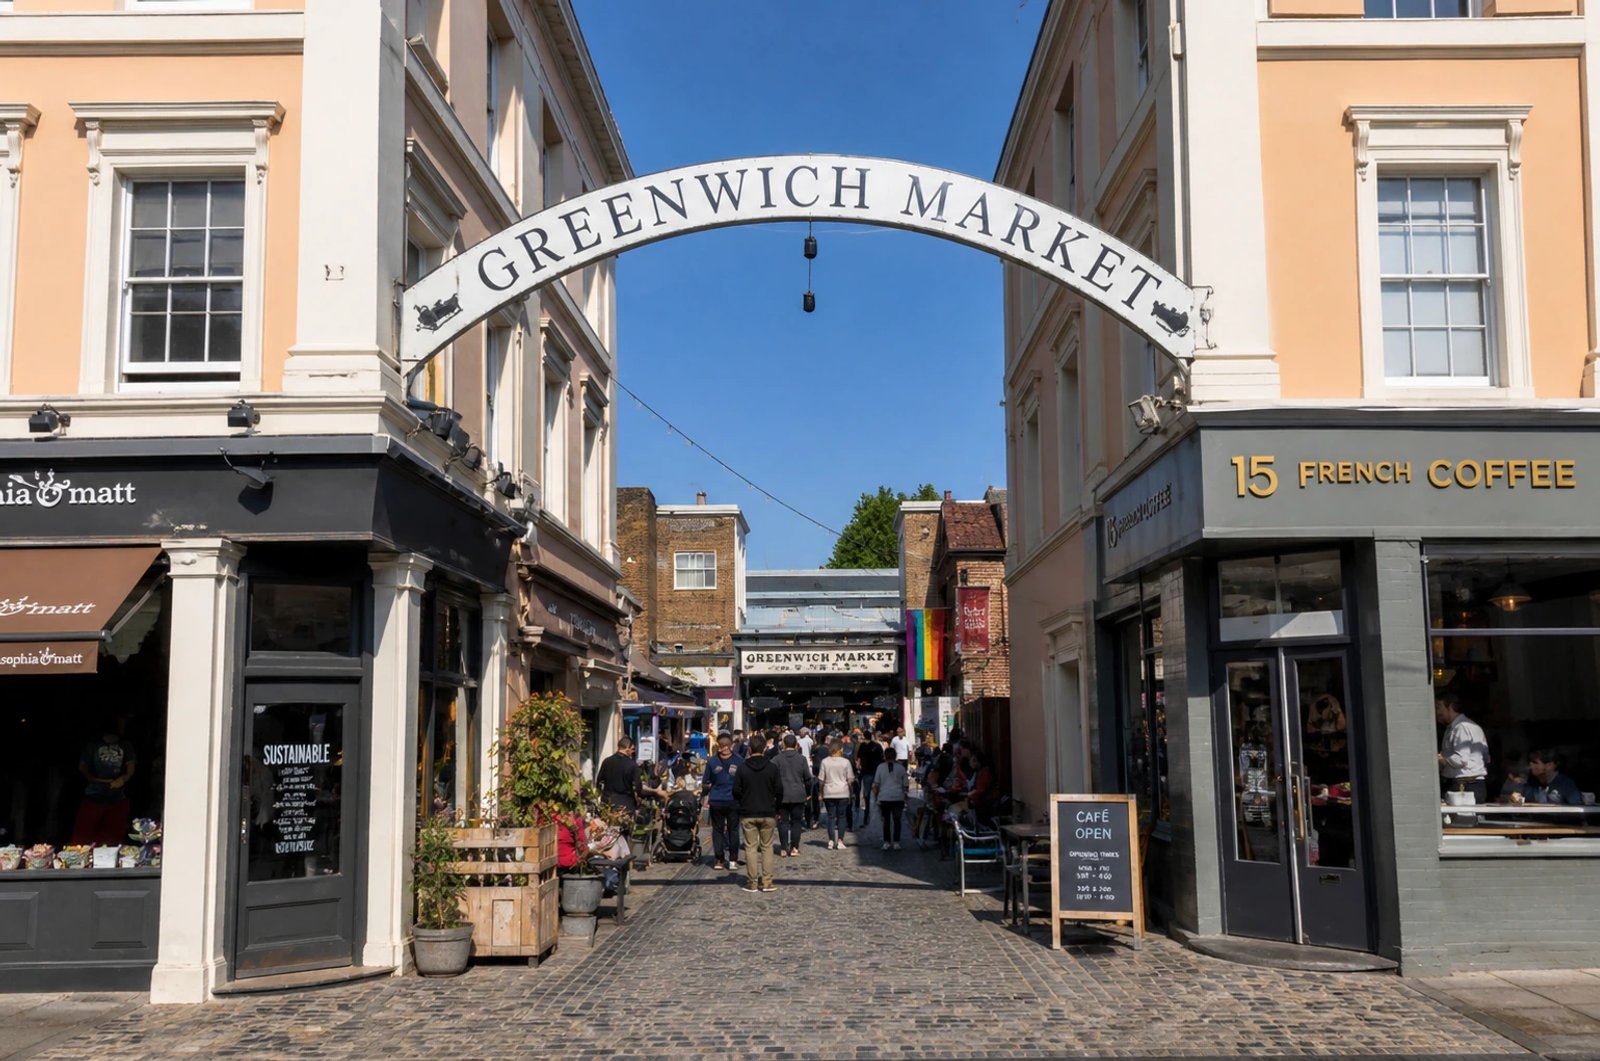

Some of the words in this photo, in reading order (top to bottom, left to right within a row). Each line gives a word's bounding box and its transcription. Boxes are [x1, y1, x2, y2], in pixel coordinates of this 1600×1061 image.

[477, 165, 871, 291] GREENWICH
[900, 174, 1162, 311] MARKET
[1231, 455, 1278, 498] 15
[1299, 461, 1412, 488] FRENCH
[1428, 459, 1577, 489] COFFEE
[835, 652, 894, 662] MARKET
[263, 744, 331, 765] SUSTAINABLE
[1076, 809, 1109, 823] CAFÉ
[1075, 828, 1112, 840] OPEN
